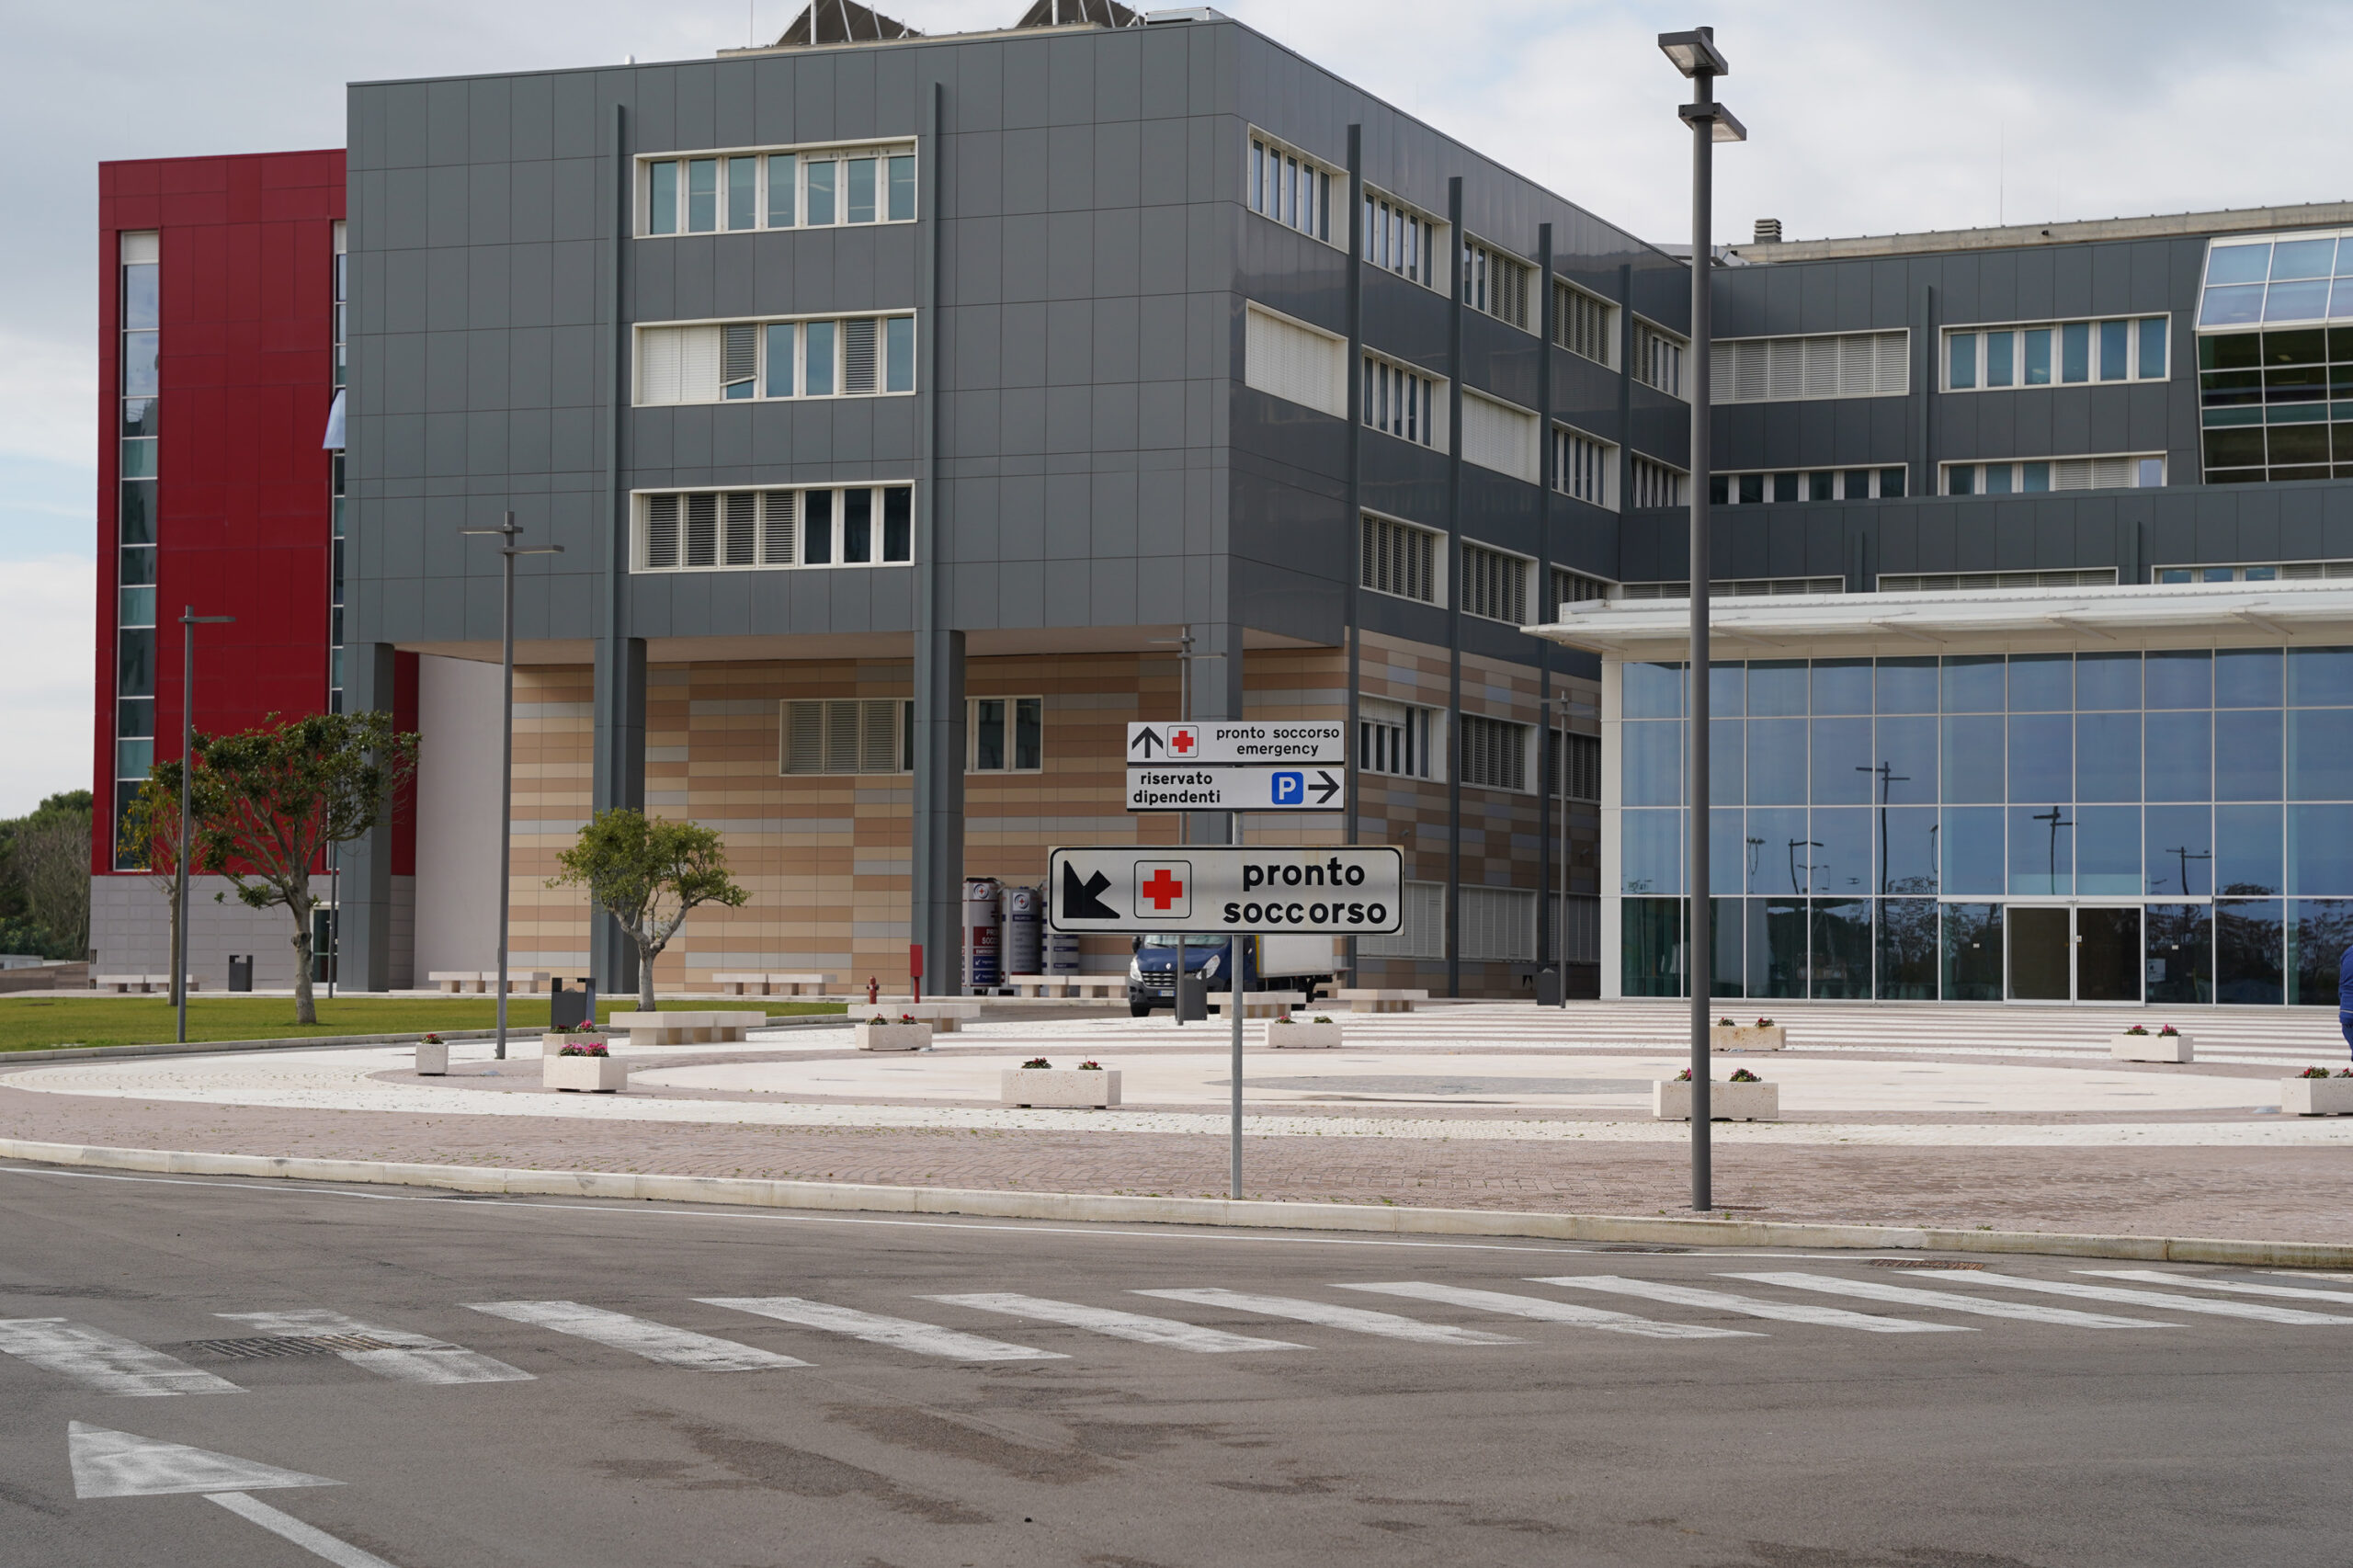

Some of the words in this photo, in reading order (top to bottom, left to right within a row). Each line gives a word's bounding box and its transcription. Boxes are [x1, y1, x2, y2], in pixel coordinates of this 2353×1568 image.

[1216, 726, 1266, 741] pronto
[1273, 728, 1340, 739] soccorso
[1236, 744, 1319, 757] emergency
[1141, 771, 1213, 785] riservato
[1132, 789, 1221, 806] dipendenti
[1279, 777, 1297, 801] P
[1243, 856, 1366, 892] pronto
[1222, 902, 1387, 925] soccorso
